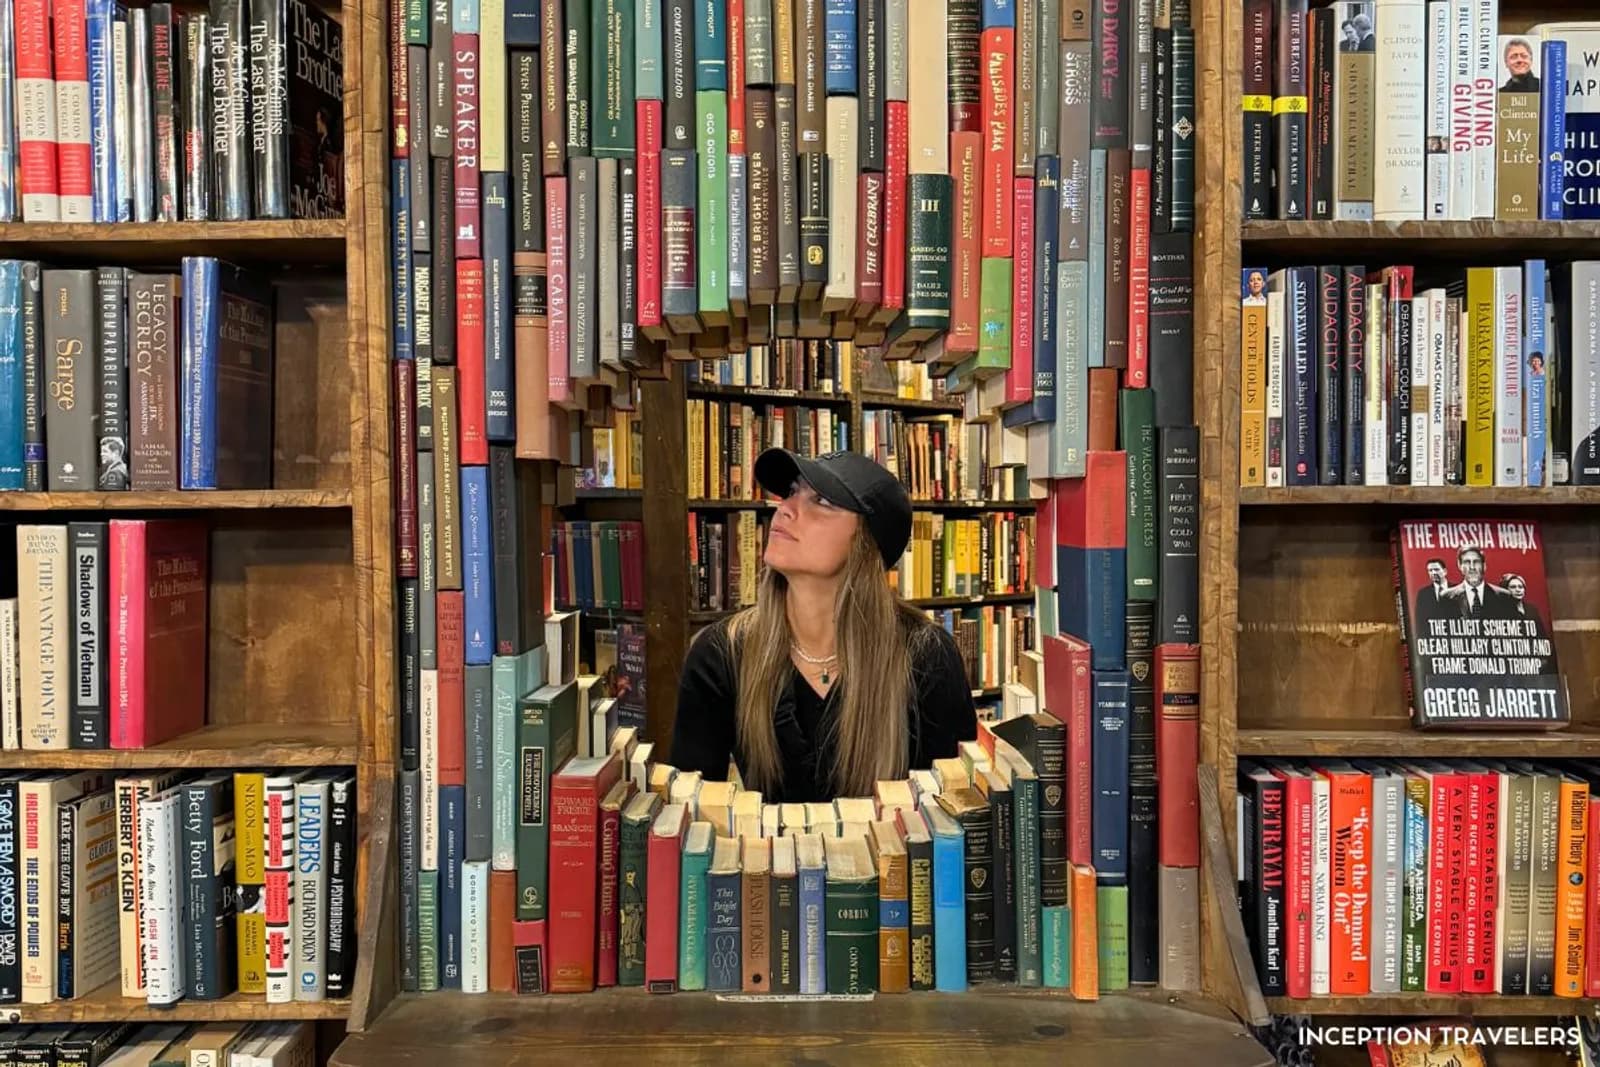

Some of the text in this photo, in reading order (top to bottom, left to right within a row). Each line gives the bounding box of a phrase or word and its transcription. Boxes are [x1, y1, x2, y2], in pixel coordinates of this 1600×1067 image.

[155, 25, 168, 90] MARK LANE
[674, 6, 684, 99] COMMUNION BLOOD
[868, 35, 876, 98] ELEVENTH VICTIM
[1102, 17, 1119, 78] DARCY
[1254, 12, 1263, 82] THE BREACH
[1459, 8, 1469, 76] BILL CLINTON
[1479, 2, 1491, 70] BILL CLINTON
[211, 24, 228, 155] The Last Brother
[231, 41, 247, 136] Joe McGinniss
[251, 21, 267, 153] The Last Brother
[456, 50, 475, 170] SPEAKER
[521, 55, 532, 144] STEVEN PRESSFIELD
[989, 52, 1008, 153] PALISADES PARK
[1065, 51, 1081, 106] STROSS
[1474, 78, 1494, 148] GIVING
[1500, 109, 1537, 120] Clinton
[1511, 97, 1527, 107] Bill
[706, 112, 716, 179] eco barons
[1453, 84, 1472, 153] GIVING
[1503, 150, 1535, 166] Life
[1507, 128, 1532, 149] My
[522, 190, 532, 232] AMAZONS
[780, 121, 792, 227] REDESIGNING HUMANS
[920, 199, 939, 213] III
[962, 159, 977, 240] JUDAS STRAIN
[1113, 174, 1125, 226] The Cove
[623, 193, 633, 252] STREET LEVEL
[753, 152, 764, 277] THIS BRIGHT RIVER
[866, 177, 881, 275] THE CELEBRANT
[549, 234, 563, 328] THE CABAL
[1113, 236, 1124, 283] Ron Rash
[136, 290, 152, 377] SECRECY
[153, 283, 167, 354] LEGACY
[414, 267, 430, 346] MARGARET MARON
[1296, 281, 1307, 374] STONEWALLED
[1325, 273, 1338, 372] AUDACITY
[1350, 273, 1363, 372] AUDACITY
[1505, 293, 1518, 397] STRATEGIC FAILURE
[25, 301, 36, 432] IN LOVE WITH NIGHT
[50, 338, 84, 411] Sarge
[103, 288, 118, 433] INCOMPARABLE GRACE
[414, 356, 430, 409] STORM TRACK
[1400, 304, 1410, 410] OBAMA COUCH
[1477, 302, 1491, 433] BARACK OBAMA
[1142, 423, 1152, 548] THE VALCOURT HEIRESS
[1404, 523, 1537, 549] THE RUSSIA HOAX
[41, 558, 55, 719] THE VANTAGE POINT
[79, 555, 97, 698] Shadows of Vietnam
[1417, 639, 1551, 656] CLEAR HILLARY CLINTON AND
[1428, 619, 1537, 637] THE ILLICIT SCHEME TO
[1431, 658, 1541, 674] FRAME DONALD TRUMP
[1423, 687, 1558, 719] GREGG JARRETT
[25, 793, 39, 849] HALDEMAN
[119, 786, 134, 912] HERBERT G. KLEIN
[187, 789, 207, 834] Betty
[245, 782, 257, 879] NIXON MAO
[299, 794, 321, 874] LEADERS
[1262, 789, 1283, 891] BETRAYAL
[1567, 790, 1587, 867] Madman Theory
[60, 811, 73, 917] MARK THE GLOVE BOY
[187, 839, 207, 880] Ford
[602, 817, 616, 916] Coming Home
[1352, 863, 1368, 890] the
[1415, 868, 1425, 921] AMERICA
[1433, 787, 1446, 967] PHILIP RUCKER CAROL LEONNIG
[1450, 787, 1463, 968] A VERY STABLE GENIUS
[1466, 784, 1479, 965] PHILIP RUCKER CAROL LEONNIG
[1483, 785, 1495, 966] A VERY STABLE GENIUS
[27, 857, 40, 957] THE ENDS OF POWER
[302, 879, 317, 963] RICHARD NIXON
[838, 908, 870, 919] CORBIN
[1267, 896, 1281, 971] Jonathan Karl
[1352, 892, 1368, 962] Damned
